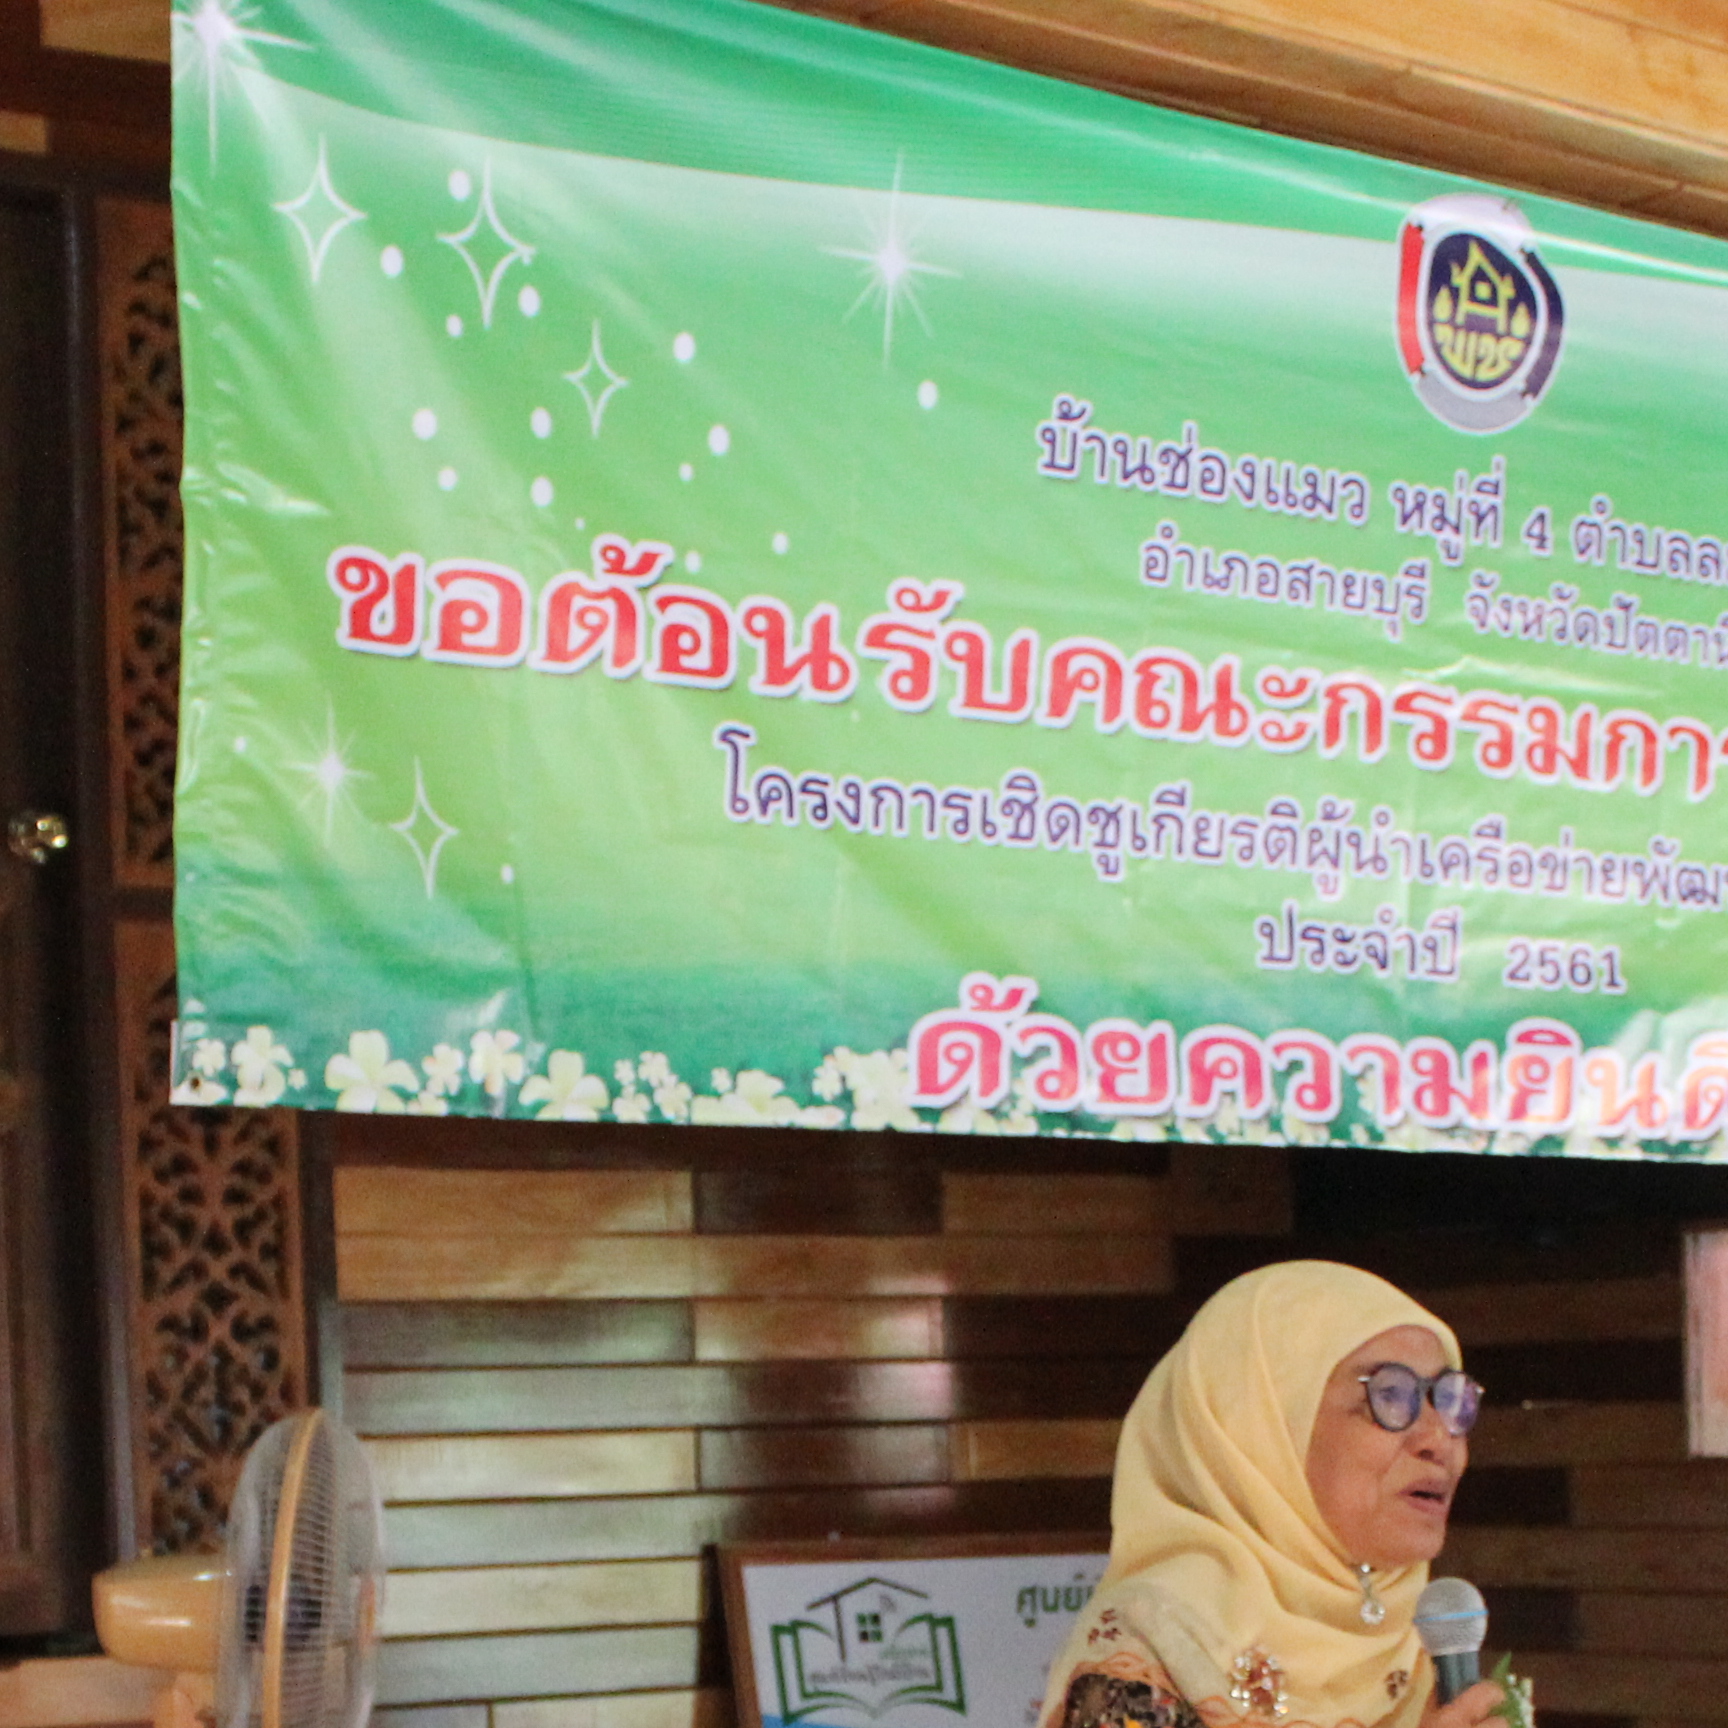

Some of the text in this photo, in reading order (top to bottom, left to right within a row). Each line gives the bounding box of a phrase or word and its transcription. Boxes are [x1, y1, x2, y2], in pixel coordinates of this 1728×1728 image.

[1039, 398, 1367, 522] บ้านช่องแมว
[1391, 458, 1503, 560] หมู่ที่
[1524, 511, 1550, 552] 4
[1143, 523, 1427, 638] อำเภอสายบุรี
[1257, 904, 1623, 990] ประจำปี 2561
